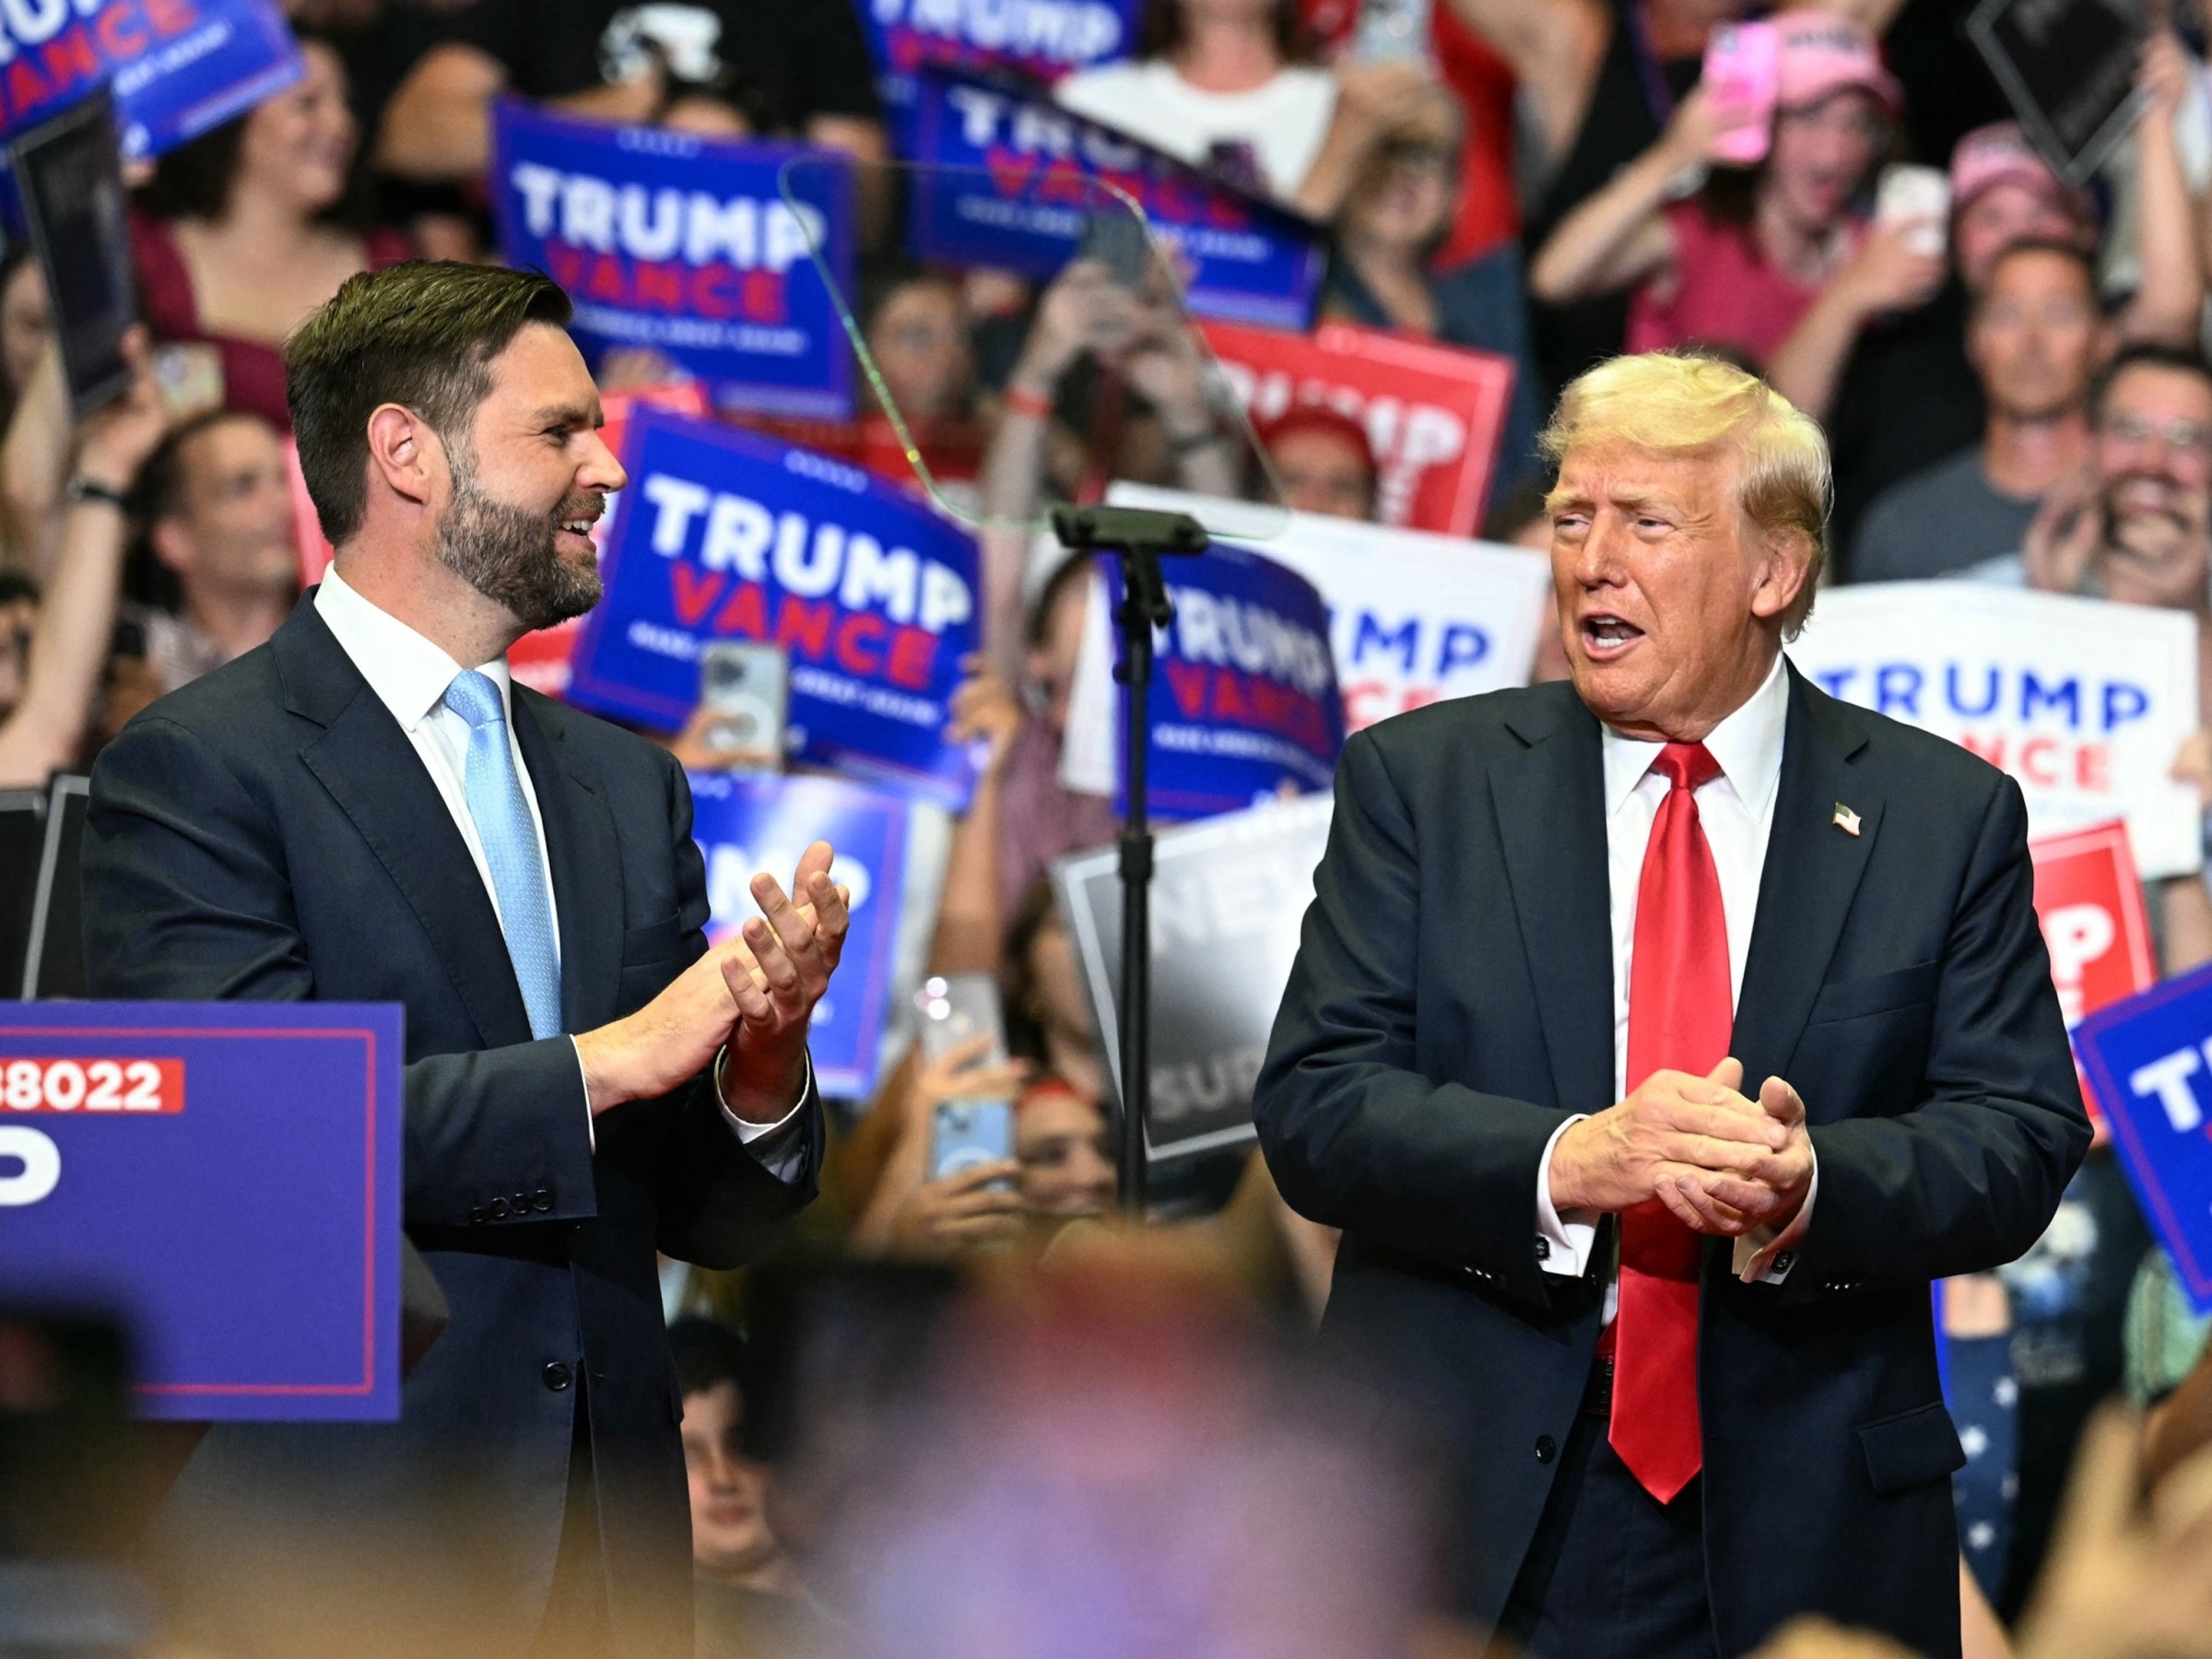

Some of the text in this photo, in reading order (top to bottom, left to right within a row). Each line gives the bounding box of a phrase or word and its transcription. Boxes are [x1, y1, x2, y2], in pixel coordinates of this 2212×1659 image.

[512, 160, 827, 273] TRUMP
[546, 238, 788, 324] VANCE
[643, 471, 973, 636] TRUMP
[669, 559, 940, 691] VANCE
[0, 1059, 163, 1112] 8022
